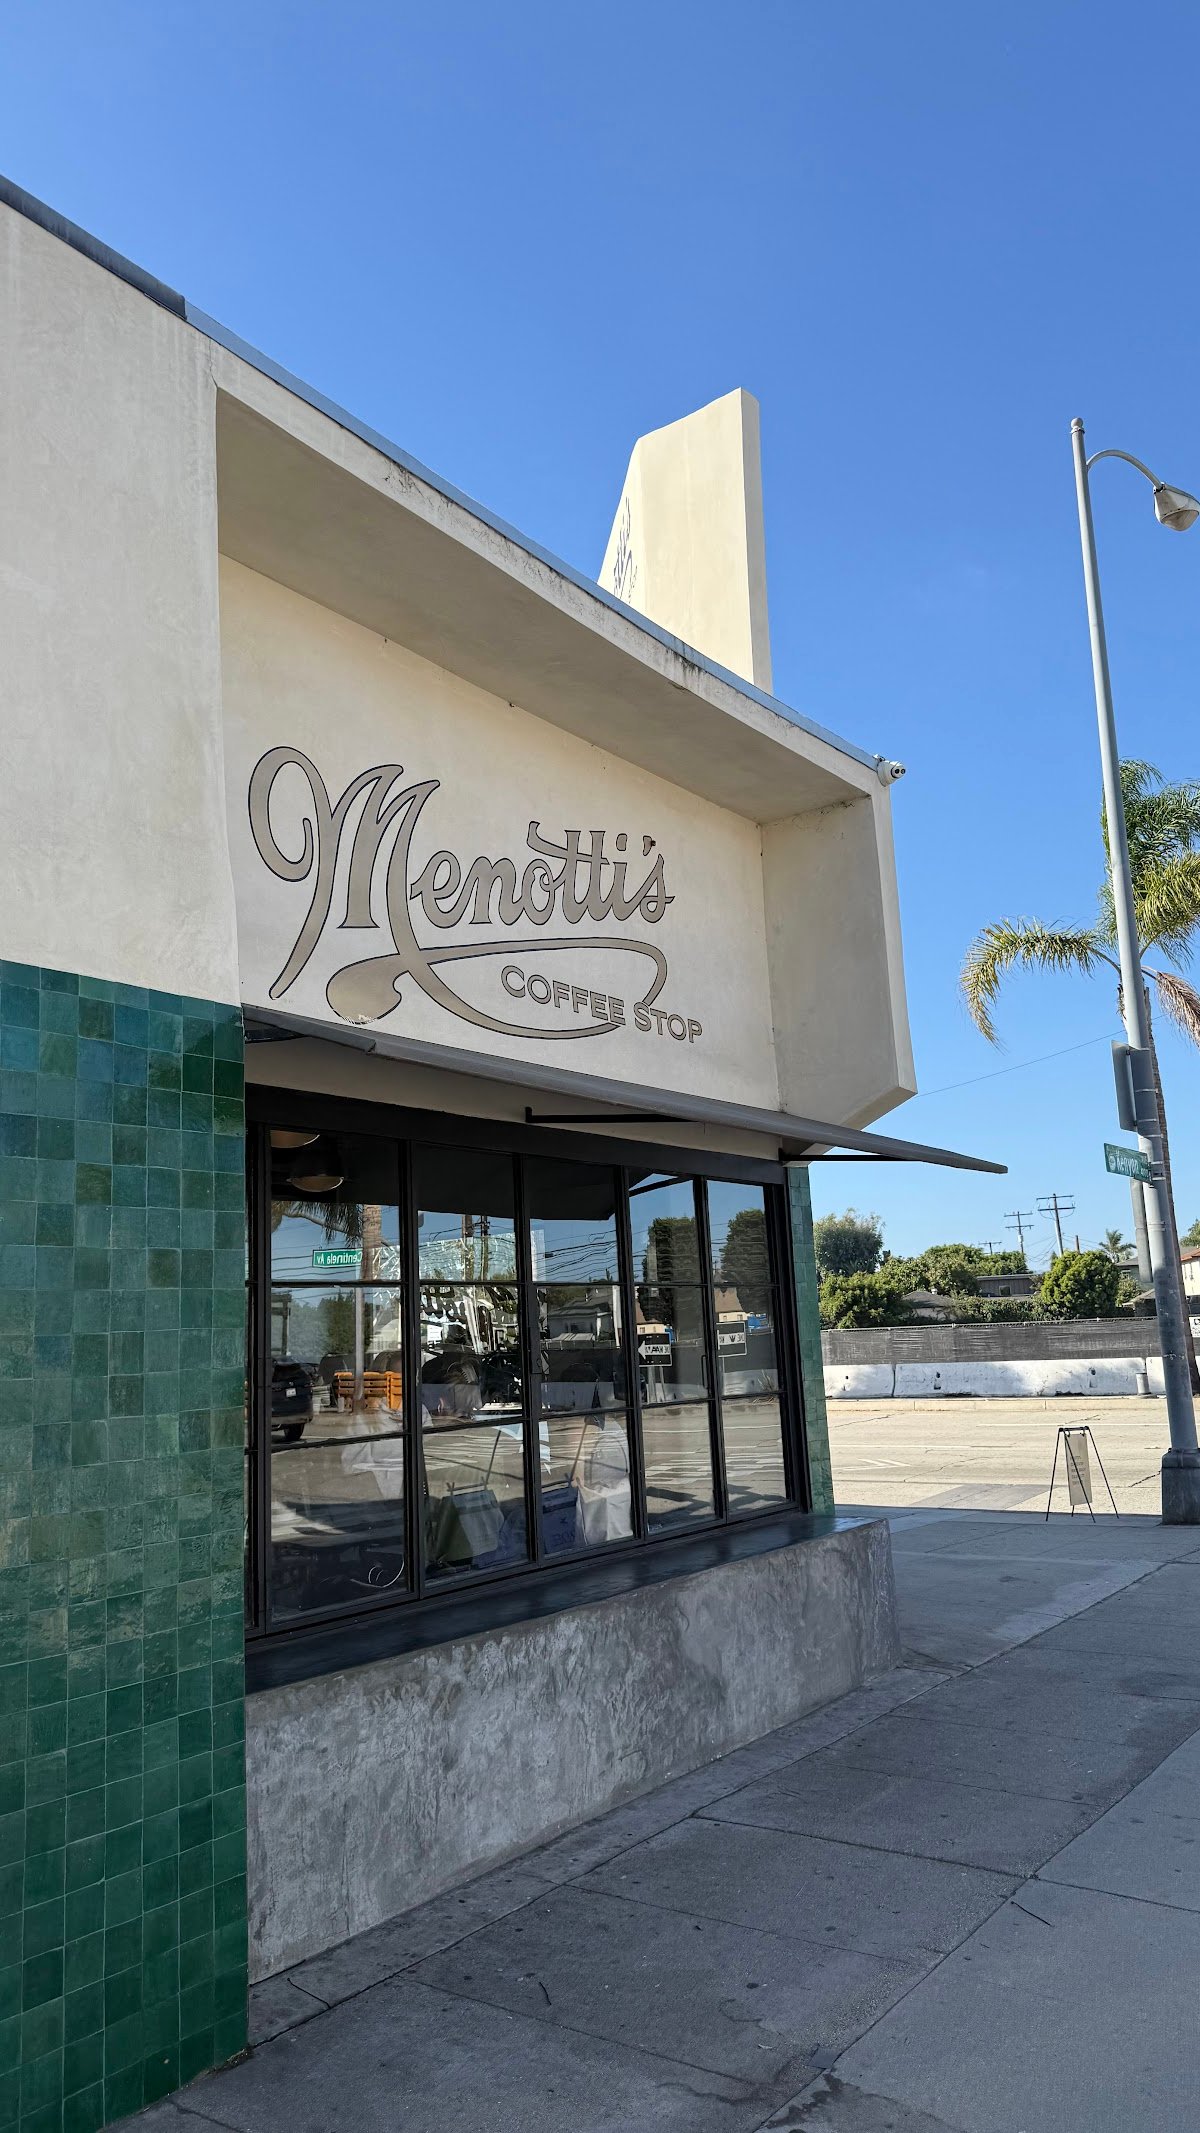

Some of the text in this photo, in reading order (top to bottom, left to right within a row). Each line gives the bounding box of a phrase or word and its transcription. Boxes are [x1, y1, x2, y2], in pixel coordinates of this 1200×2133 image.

[248, 745, 675, 1003] Menotti's
[501, 965, 703, 1043] COFFEE STOP
